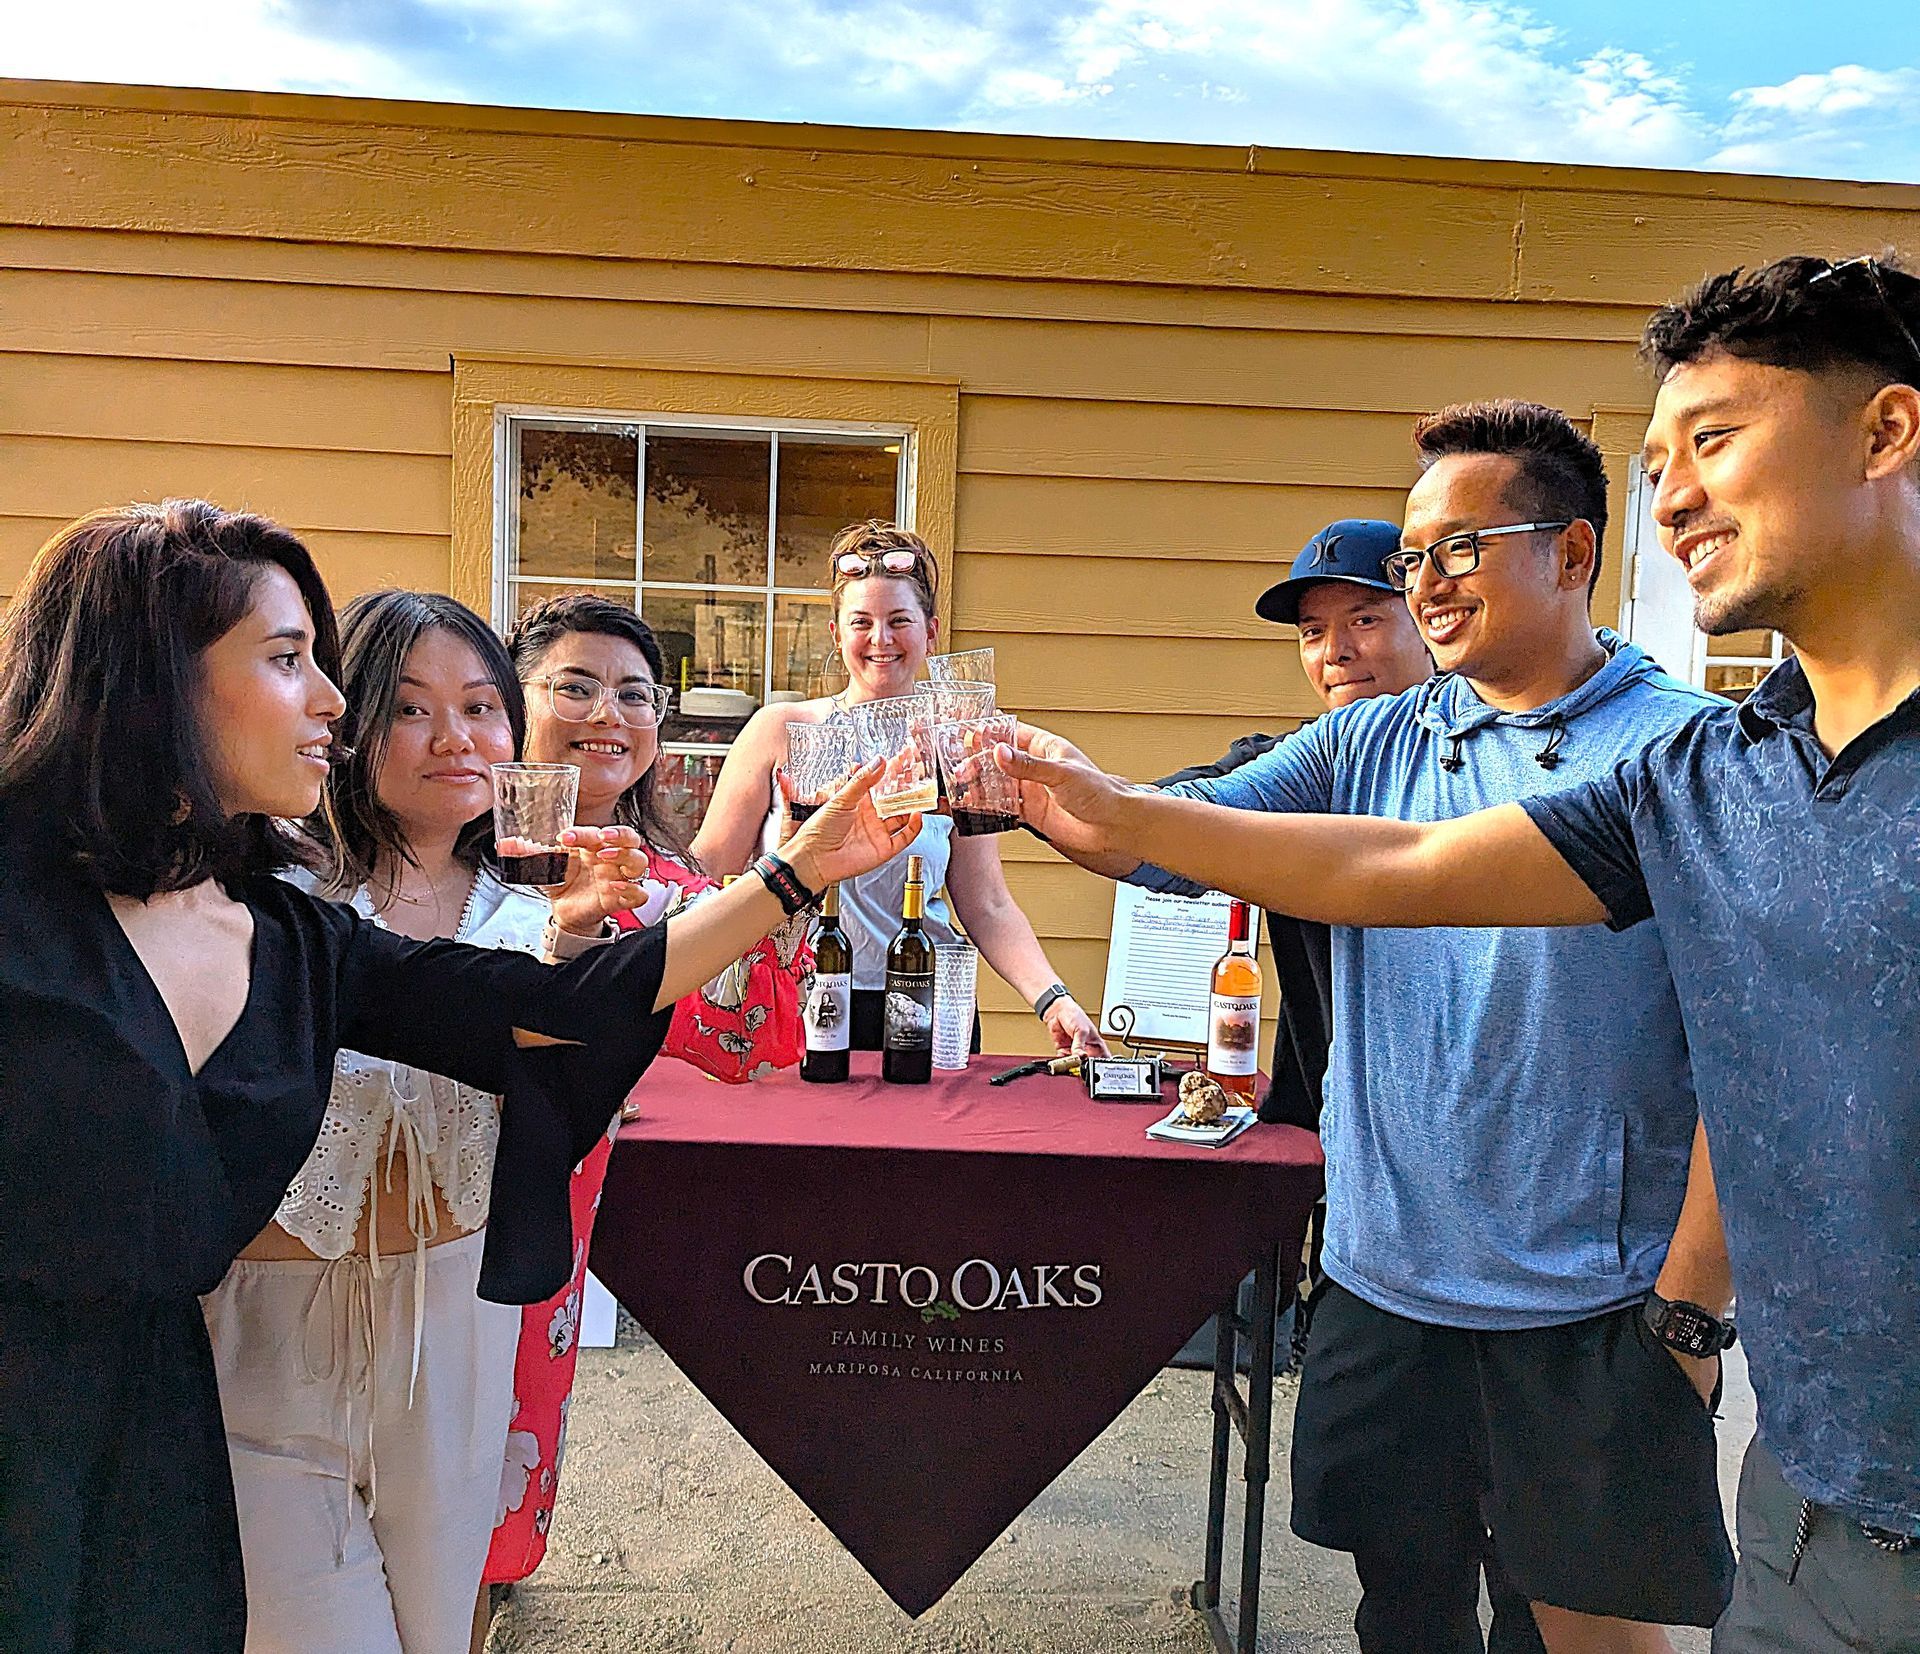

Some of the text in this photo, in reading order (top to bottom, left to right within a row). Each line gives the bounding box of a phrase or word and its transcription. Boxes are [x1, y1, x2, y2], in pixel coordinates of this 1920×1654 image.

[1213, 1000, 1238, 1010] CASTO
[743, 1253, 1102, 1311] CASTO OAKS
[831, 1329, 1006, 1353] FAMILY WINES
[809, 1362, 1024, 1382] MARIPOSA CALIFORNIA
